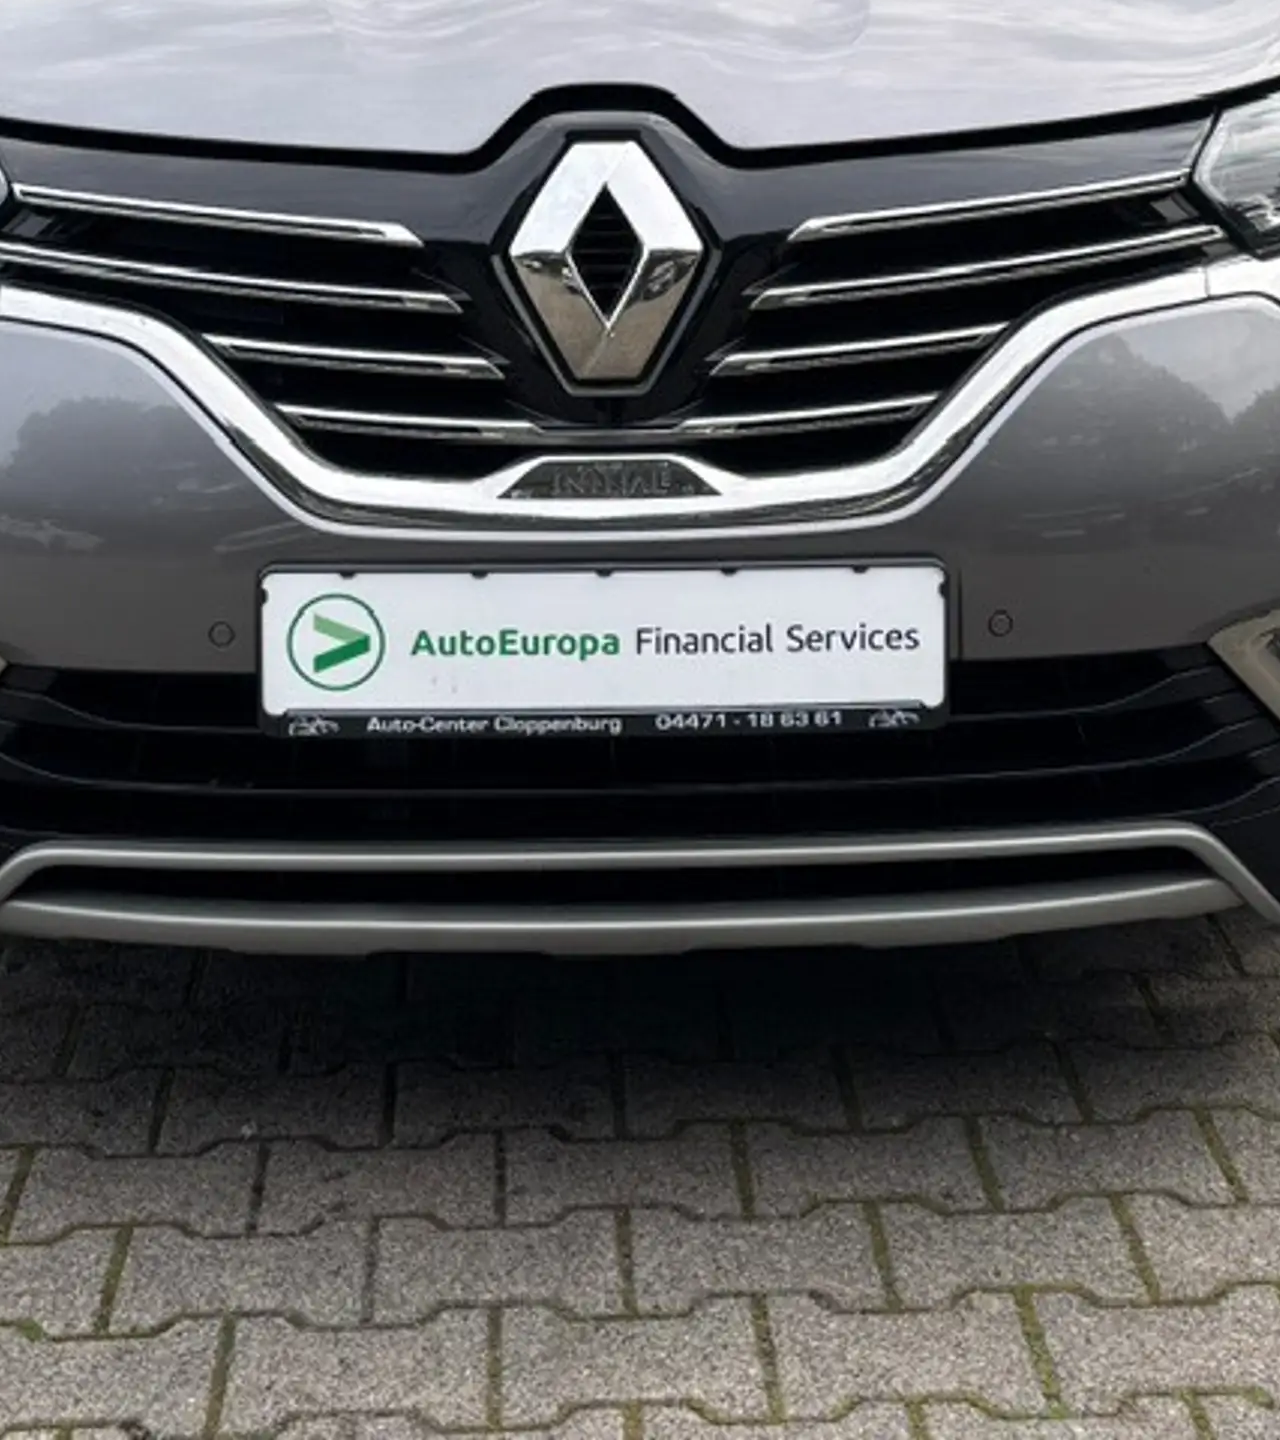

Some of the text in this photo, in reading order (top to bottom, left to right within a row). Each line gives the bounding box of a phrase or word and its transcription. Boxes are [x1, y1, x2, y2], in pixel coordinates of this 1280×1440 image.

[410, 621, 920, 661] AutoEuropa Financial Services
[367, 715, 622, 736] Auto-Center Cloppenburg
[655, 712, 726, 730] 04471
